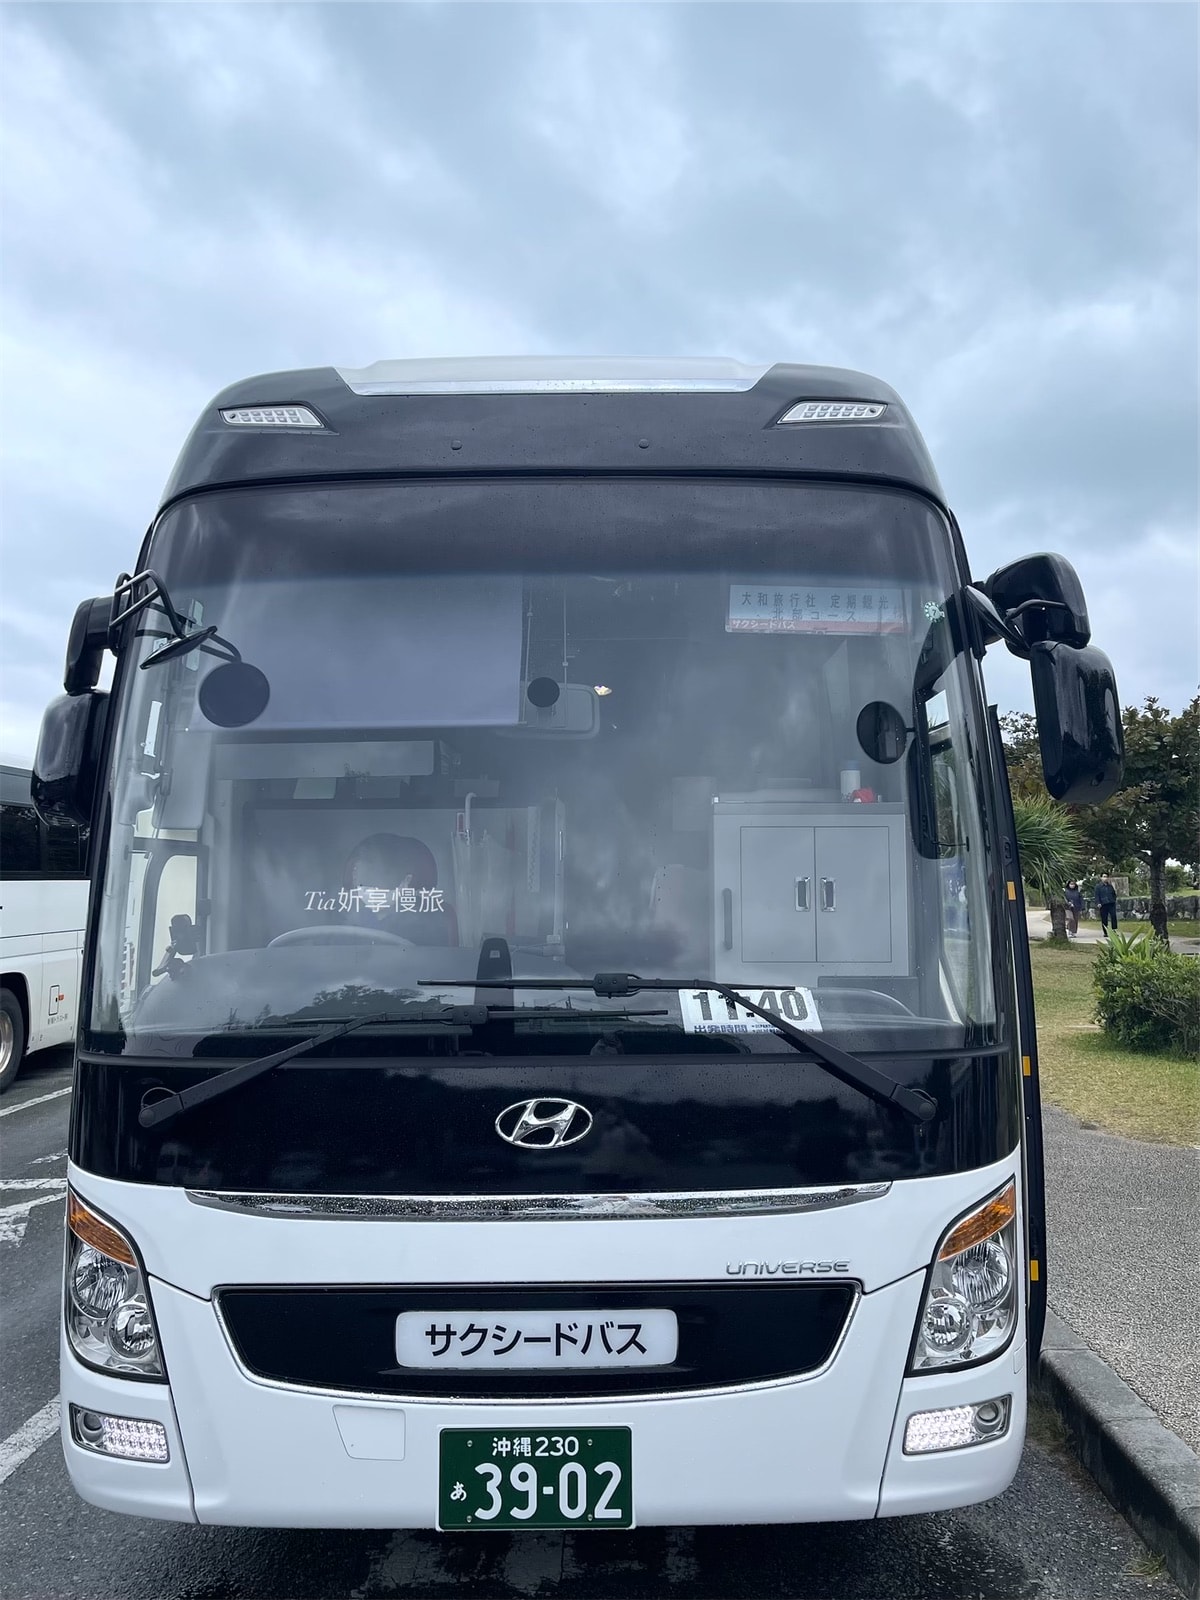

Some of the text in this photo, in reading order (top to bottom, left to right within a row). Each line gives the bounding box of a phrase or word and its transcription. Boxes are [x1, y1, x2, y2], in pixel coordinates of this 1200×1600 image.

[726, 1259, 851, 1275] UNIVERSE
[424, 1322, 648, 1357] サクシードバス
[450, 1461, 622, 1520] あ 39-02
